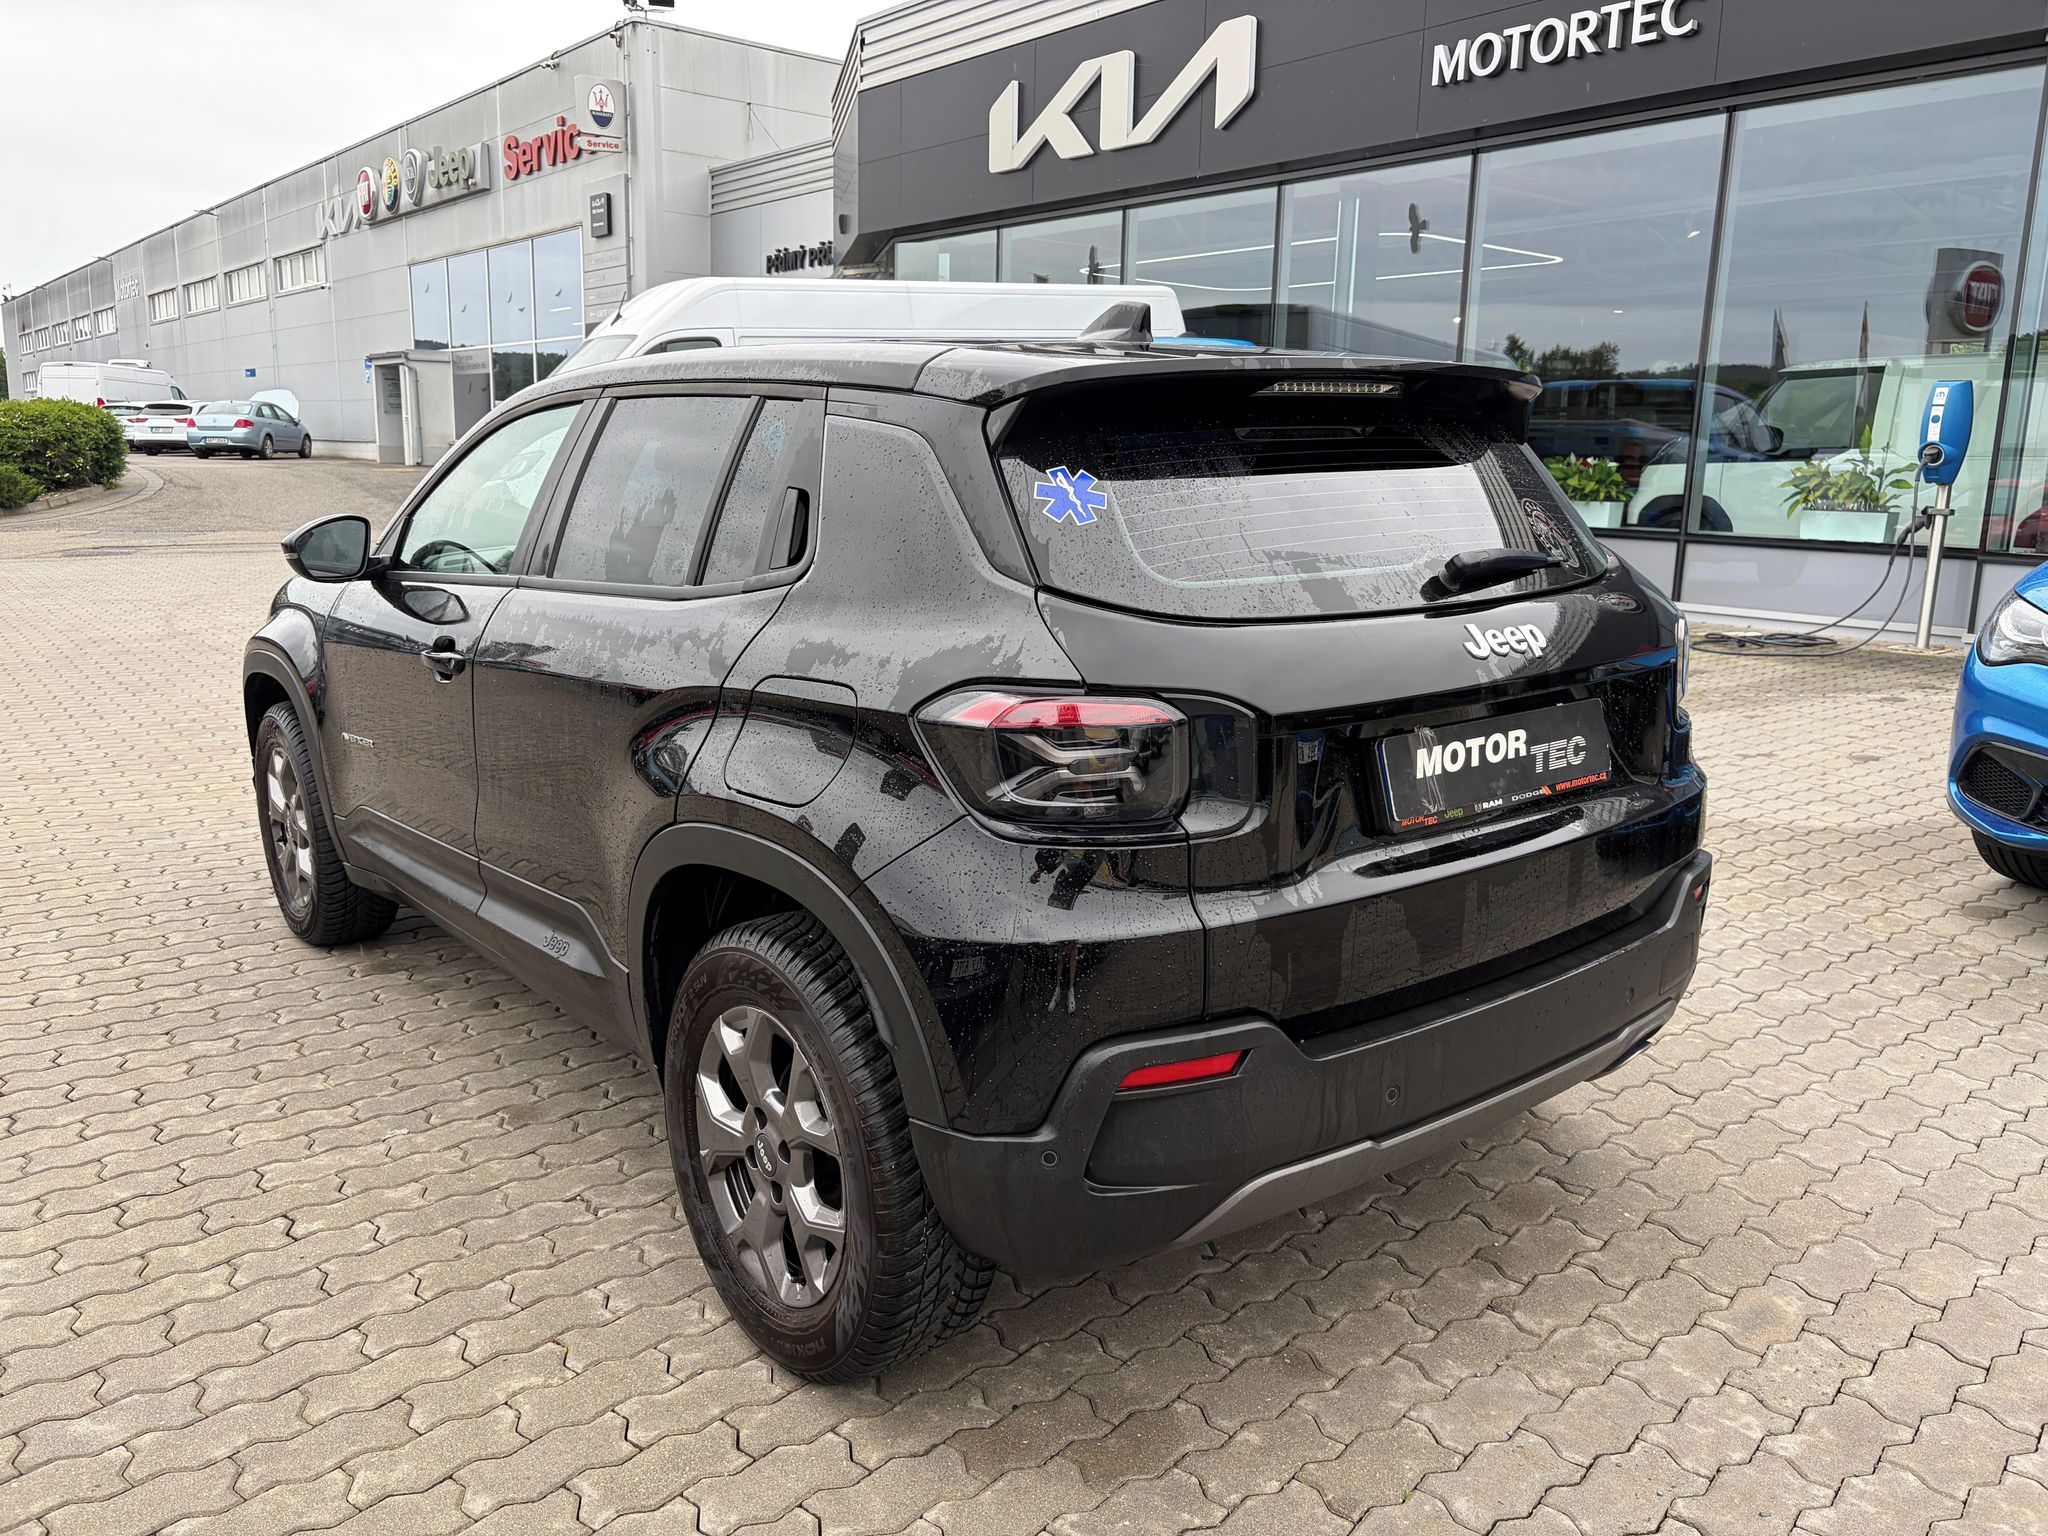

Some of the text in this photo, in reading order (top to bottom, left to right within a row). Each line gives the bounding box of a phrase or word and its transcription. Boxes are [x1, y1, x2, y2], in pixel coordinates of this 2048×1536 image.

[1431, 0, 1698, 87] MOTORTEC
[989, 15, 1258, 173] KIA
[503, 115, 594, 180] Servic
[587, 140, 620, 149] Service
[428, 146, 473, 189] Jeep
[1463, 624, 1547, 660] Jeep
[1416, 728, 1587, 779] MOTOR TEC
[1555, 772, 1607, 791] www.motortec.cz
[1444, 807, 1464, 819] Jeep
[1482, 799, 1503, 810] RAM
[543, 930, 570, 957] Jeep
[757, 1140, 772, 1171] Jeep
